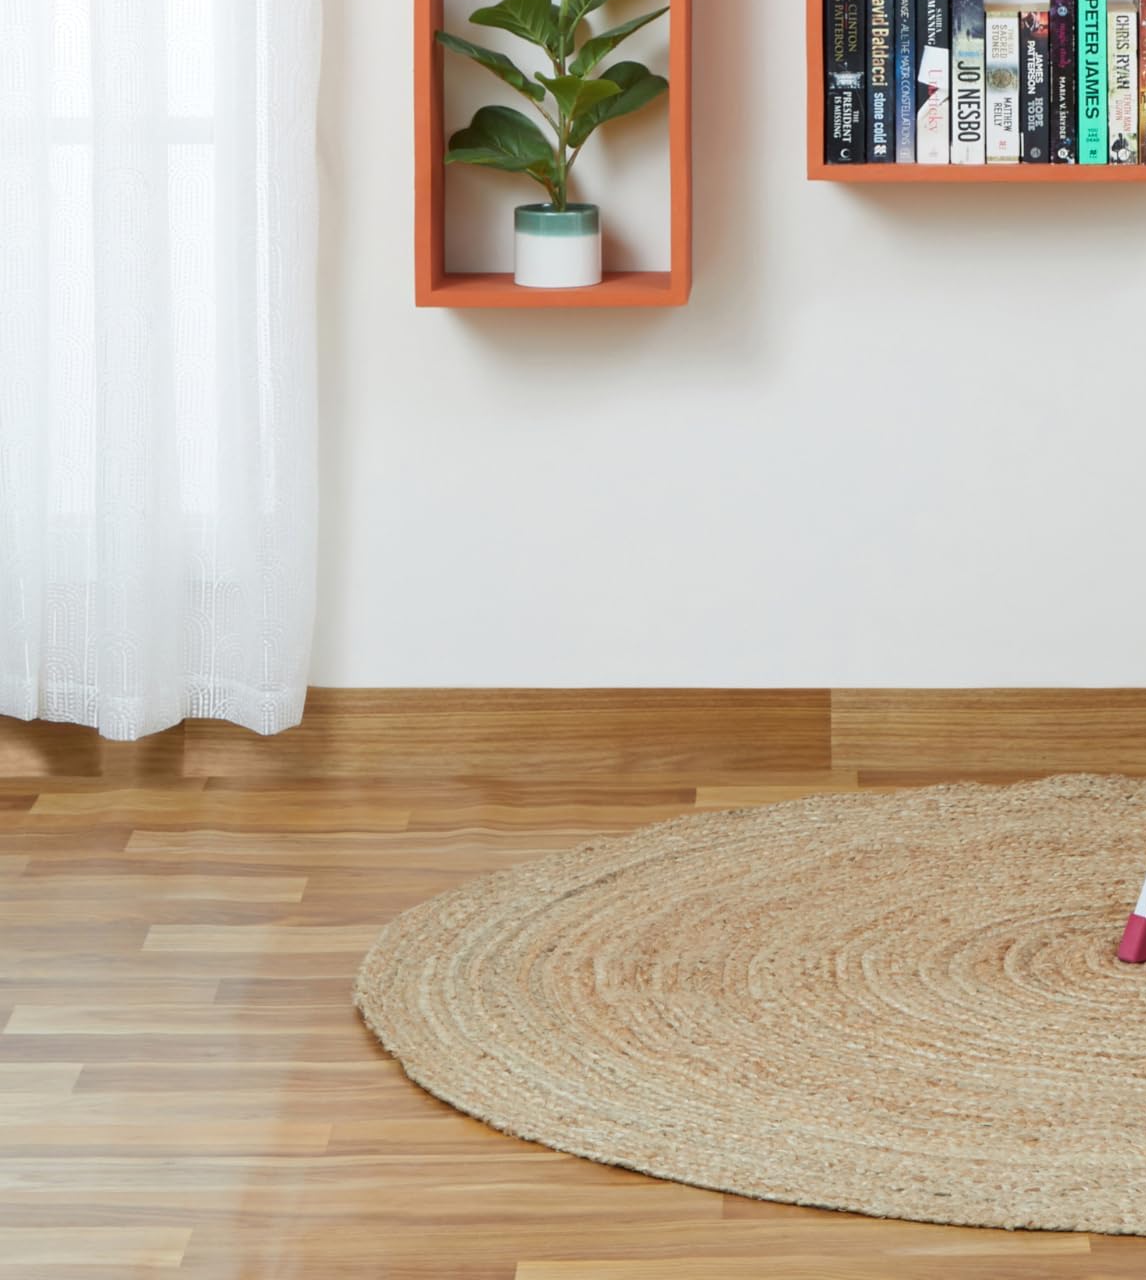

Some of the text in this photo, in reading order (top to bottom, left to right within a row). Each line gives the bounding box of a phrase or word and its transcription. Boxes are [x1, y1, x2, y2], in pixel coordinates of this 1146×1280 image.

[834, 5, 845, 61] PATTERSON
[847, 4, 858, 52] CLINTON
[900, 24, 911, 40] ALL
[927, 0, 936, 46] MANNING
[871, 28, 889, 86] Baldacci
[900, 40, 910, 54] THE
[992, 24, 1000, 59] STONES
[1000, 24, 1008, 59] SACRED
[1115, 15, 1129, 90] CHRIS RYAN
[901, 55, 911, 79] MAJOR
[957, 60, 981, 82] JO
[1027, 40, 1036, 95] PATTERSON
[1035, 52, 1044, 83] JAMES
[834, 96, 842, 104] IS
[1059, 76, 1067, 102] MARIA
[1085, 59, 1099, 119] JAMES
[842, 91, 852, 143] PRESIDENT
[874, 92, 886, 143] stone cold
[901, 80, 911, 145] CONSTELLATIONS
[994, 102, 1003, 127] REILLY
[1003, 97, 1013, 132] MATTHEW
[1028, 101, 1036, 131] TO DIE
[1036, 97, 1044, 127] HOPE
[1059, 111, 1068, 139] SNYDER
